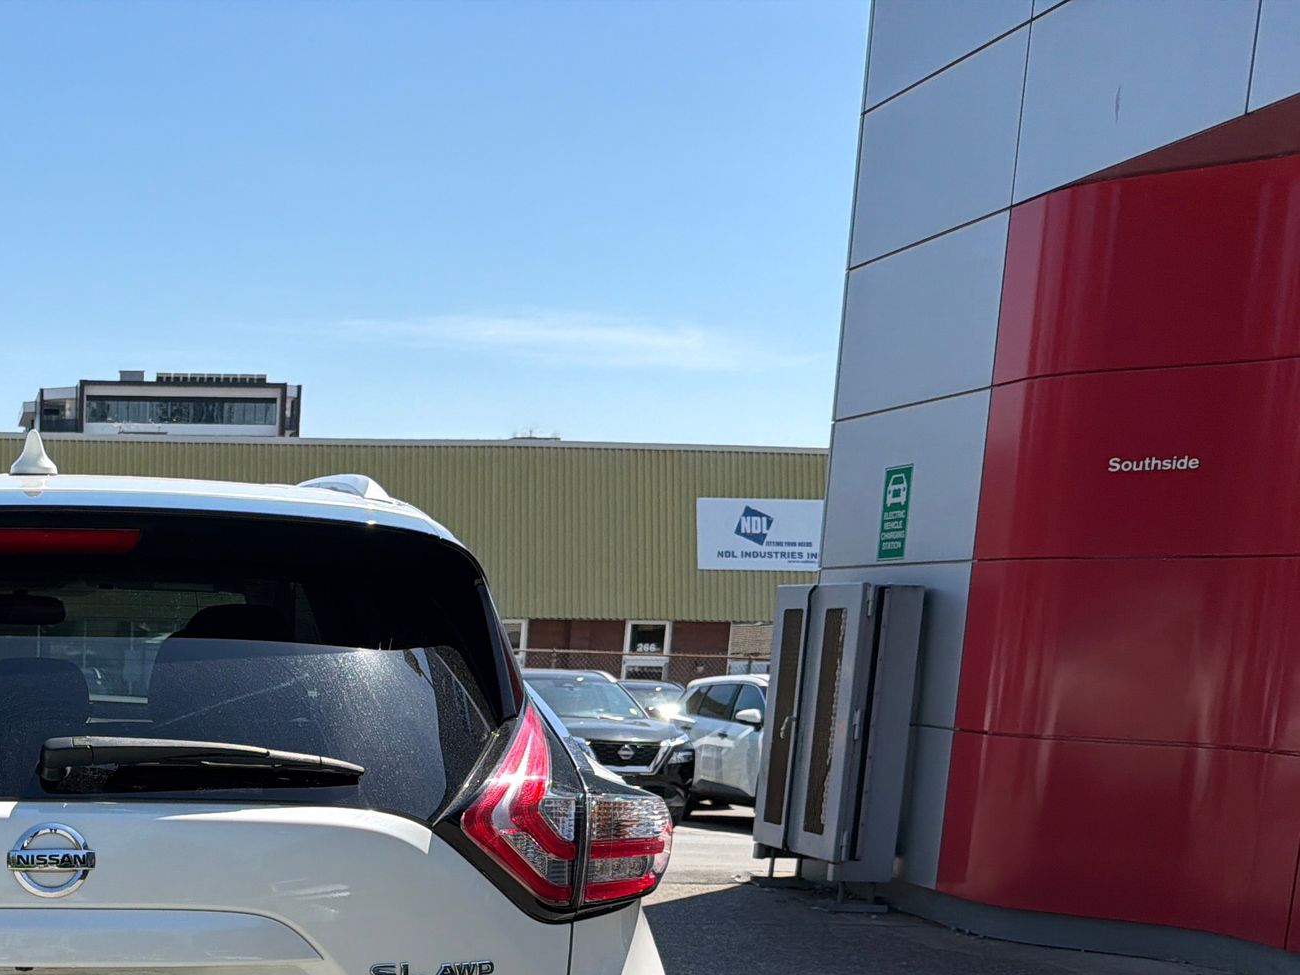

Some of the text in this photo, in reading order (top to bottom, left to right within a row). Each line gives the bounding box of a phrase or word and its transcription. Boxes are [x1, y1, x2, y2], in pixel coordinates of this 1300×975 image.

[1108, 455, 1200, 472] Southside
[741, 516, 769, 534] NDL
[717, 550, 738, 559] NDL
[741, 551, 804, 560] INDUSTRIES
[636, 643, 656, 651] 266
[16, 854, 86, 865] NISSAN
